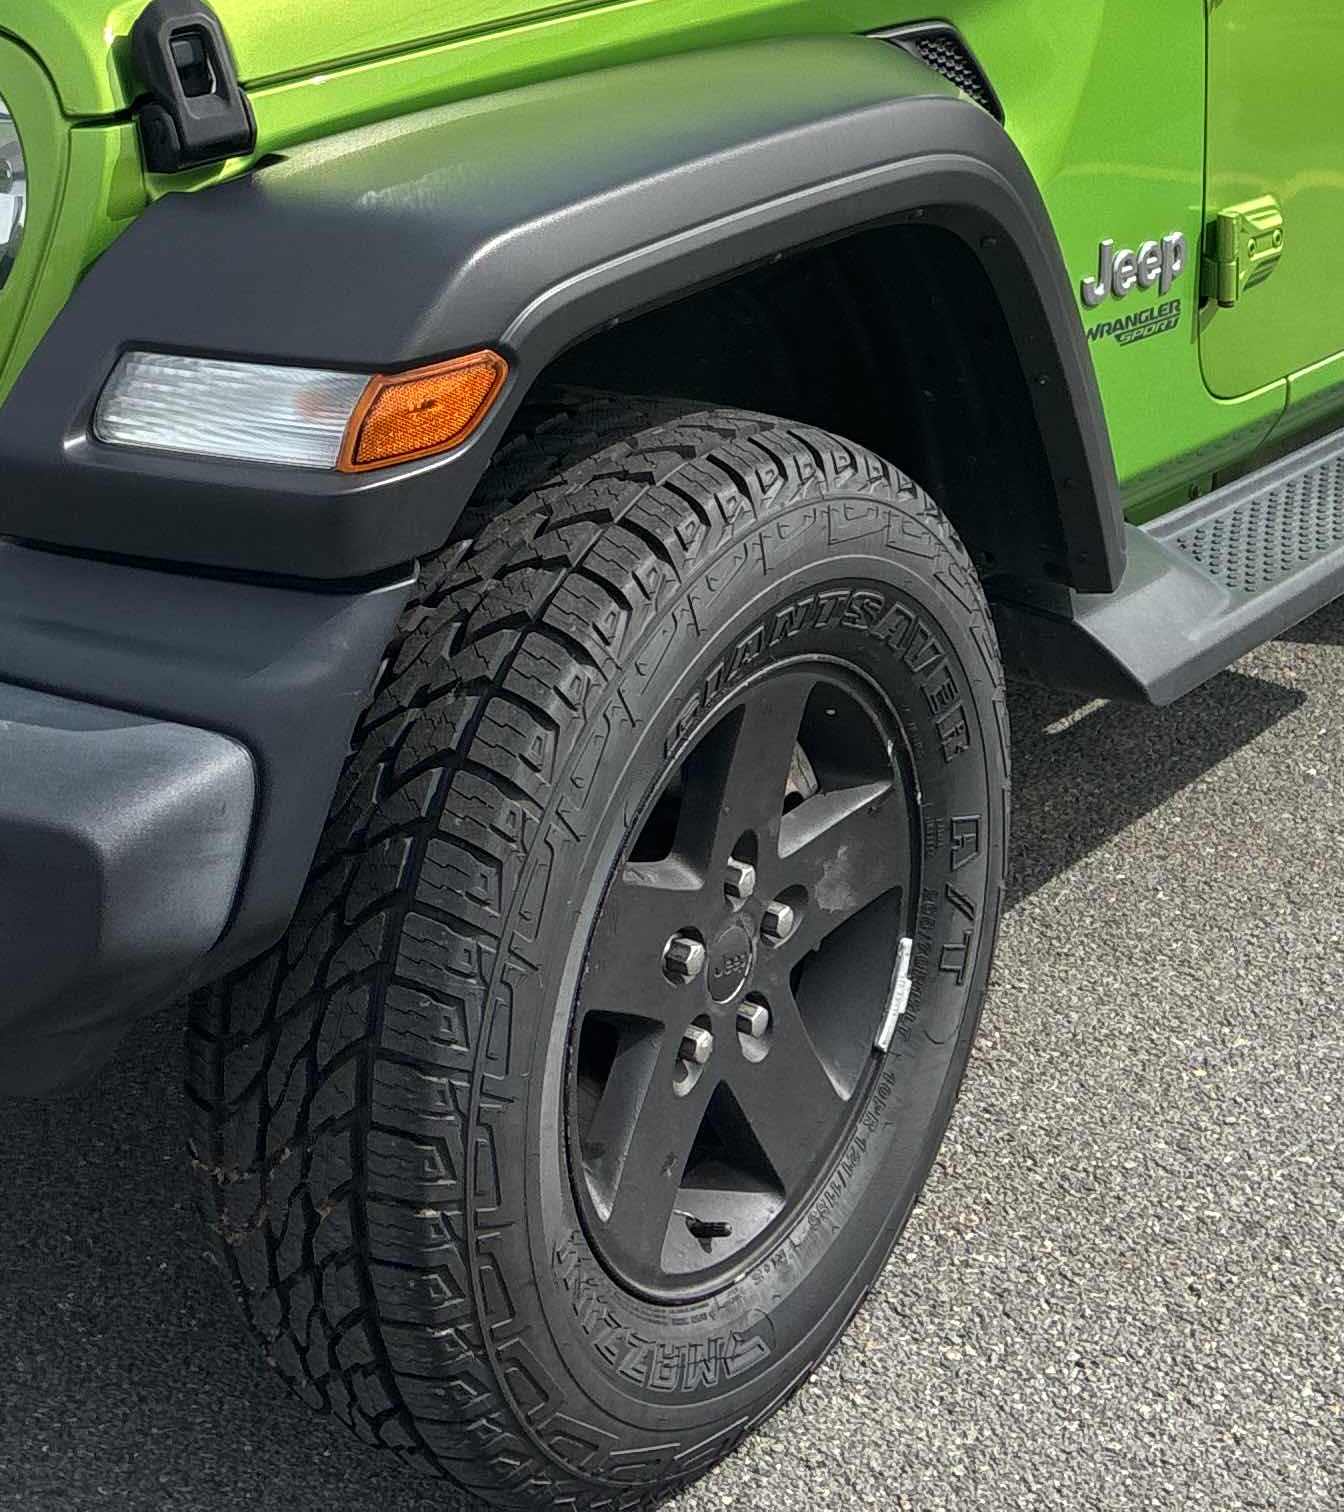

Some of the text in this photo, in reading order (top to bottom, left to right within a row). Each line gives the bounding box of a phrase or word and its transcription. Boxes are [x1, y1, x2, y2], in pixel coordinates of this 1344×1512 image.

[1080, 232, 1186, 309] Jeep
[1087, 299, 1181, 341] WRANGLER
[1114, 316, 1180, 346] SPORT
[714, 954, 747, 978] Jeep
